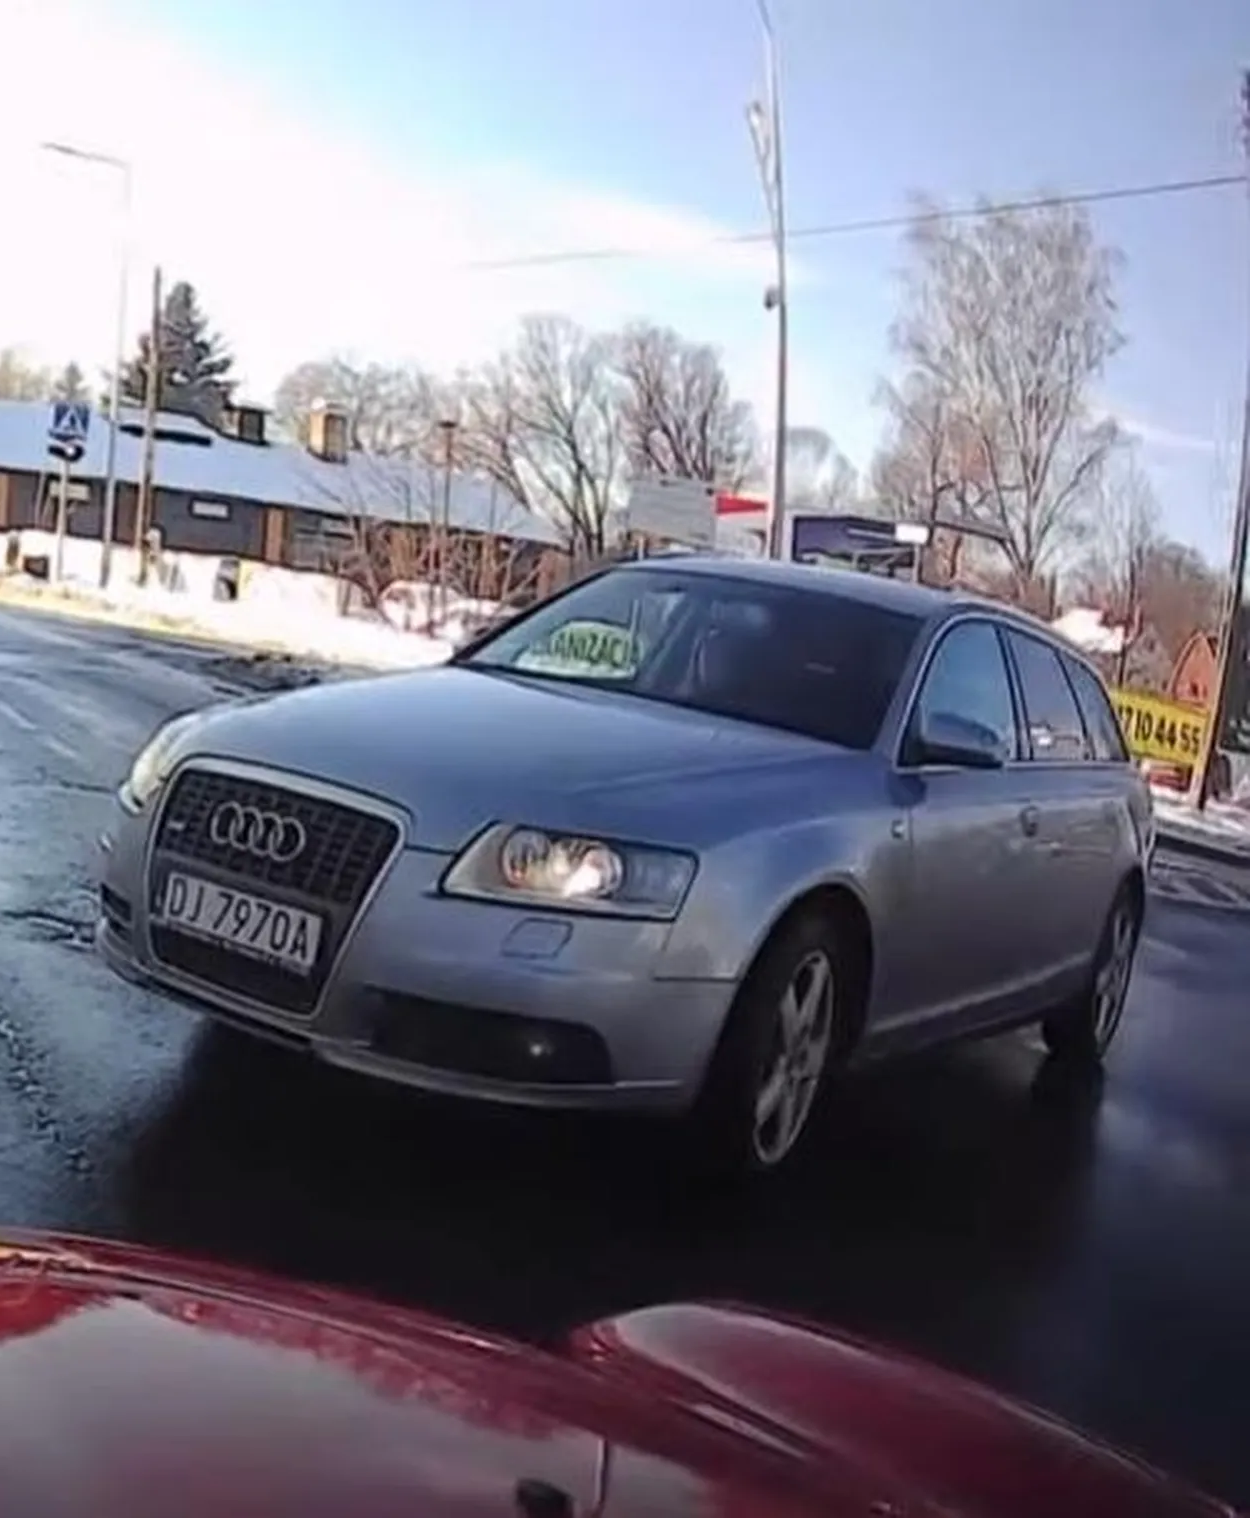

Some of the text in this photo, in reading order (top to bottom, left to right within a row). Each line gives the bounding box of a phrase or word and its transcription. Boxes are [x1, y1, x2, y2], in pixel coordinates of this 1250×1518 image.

[1155, 717, 1177, 749] 44
[1181, 722, 1200, 756] 55
[213, 891, 308, 960] 7970A
